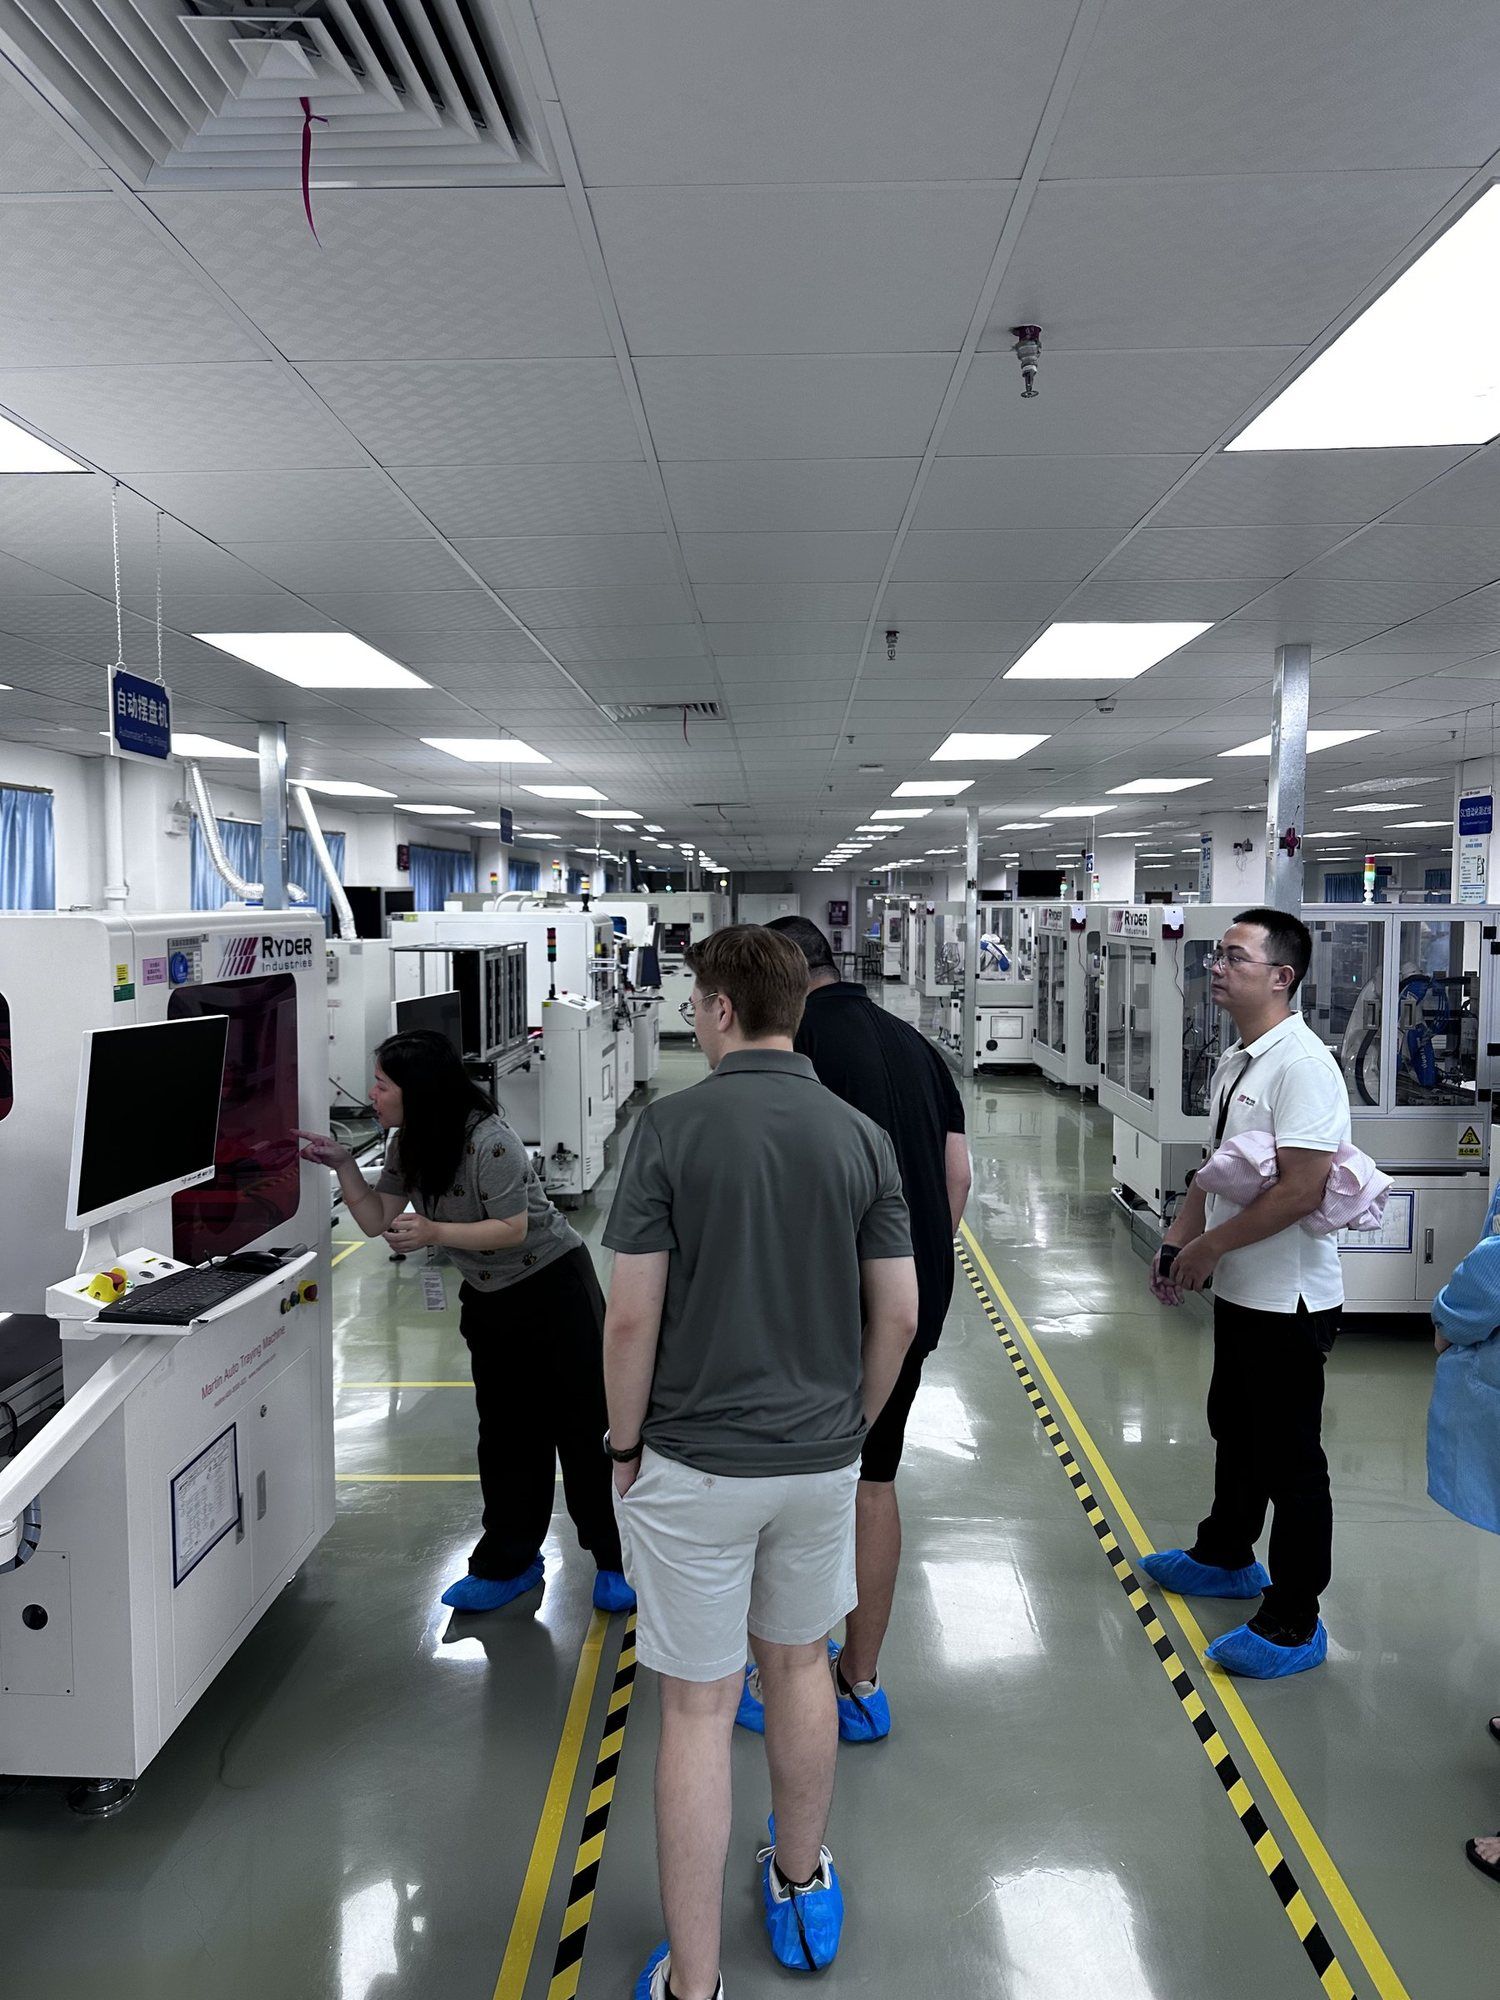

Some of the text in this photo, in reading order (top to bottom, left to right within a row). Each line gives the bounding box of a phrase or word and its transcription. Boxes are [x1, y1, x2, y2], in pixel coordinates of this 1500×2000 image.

[117, 687, 168, 729] 自动摆盘机
[1124, 910, 1148, 926] RYDER
[261, 936, 312, 959] RYDER
[262, 960, 312, 972] Industries
[201, 1375, 222, 1400] Martin
[223, 1363, 240, 1382] Auto
[240, 1344, 262, 1368] Traying
[262, 1324, 286, 1351] Machine
